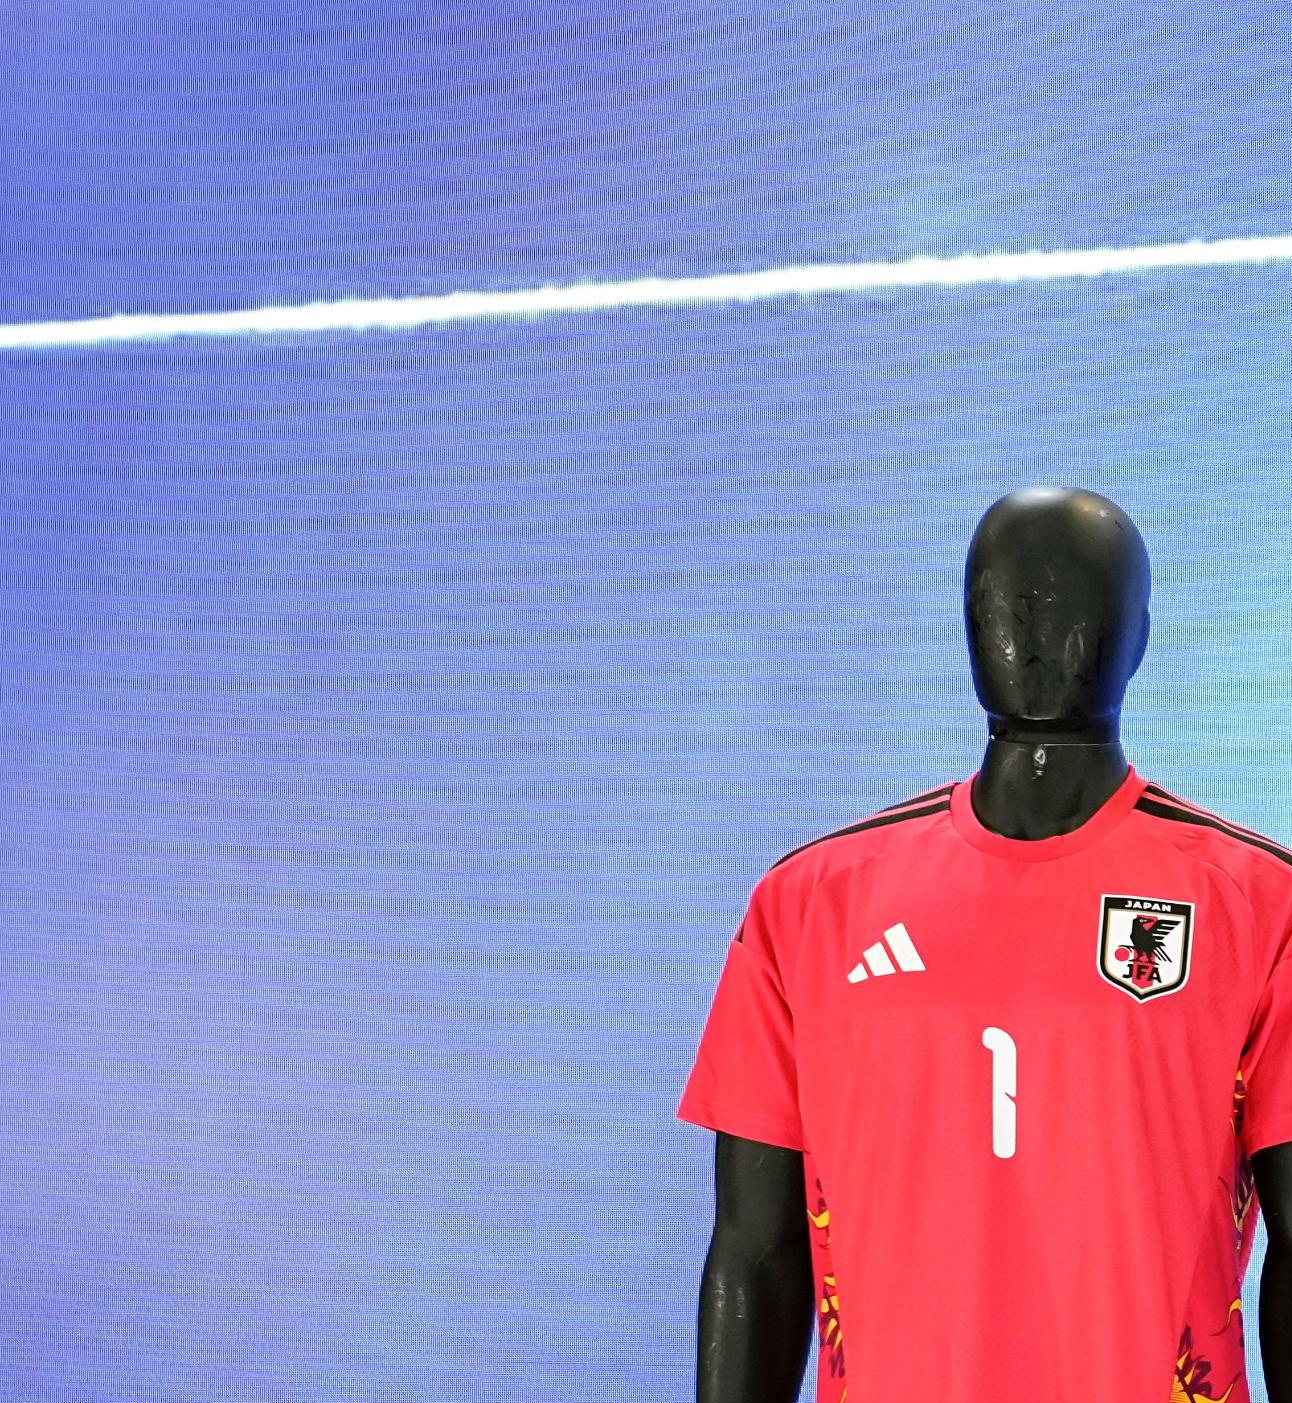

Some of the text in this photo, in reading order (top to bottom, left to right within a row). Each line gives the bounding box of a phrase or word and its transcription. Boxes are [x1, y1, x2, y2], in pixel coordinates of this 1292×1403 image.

[1124, 900, 1172, 912] JAPAN
[1122, 963, 1163, 983] JFA
[982, 1026, 1017, 1159] 1
